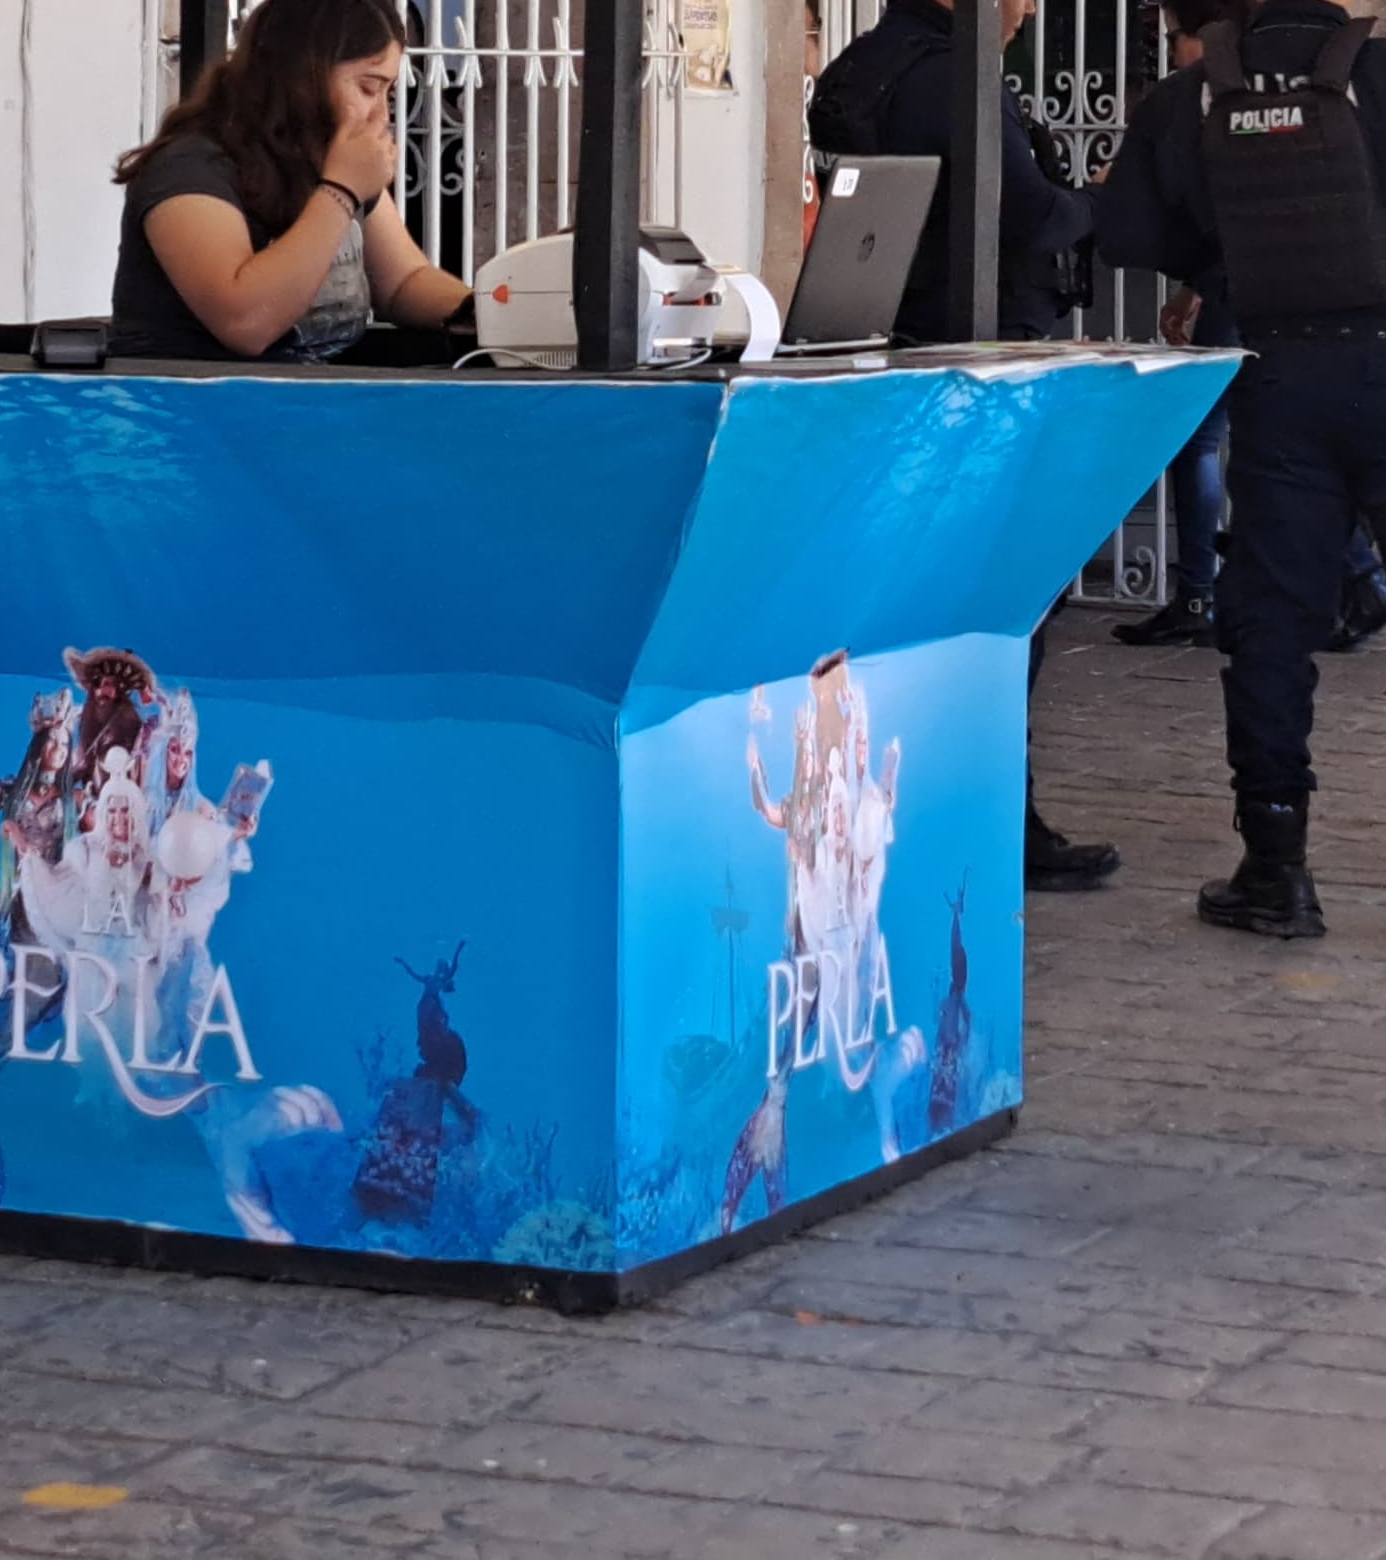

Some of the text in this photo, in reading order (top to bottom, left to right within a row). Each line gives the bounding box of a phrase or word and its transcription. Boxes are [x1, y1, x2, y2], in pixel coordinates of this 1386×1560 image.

[1230, 106, 1304, 131] POLICIA
[80, 891, 156, 937] LA
[766, 931, 898, 1092] PERLA
